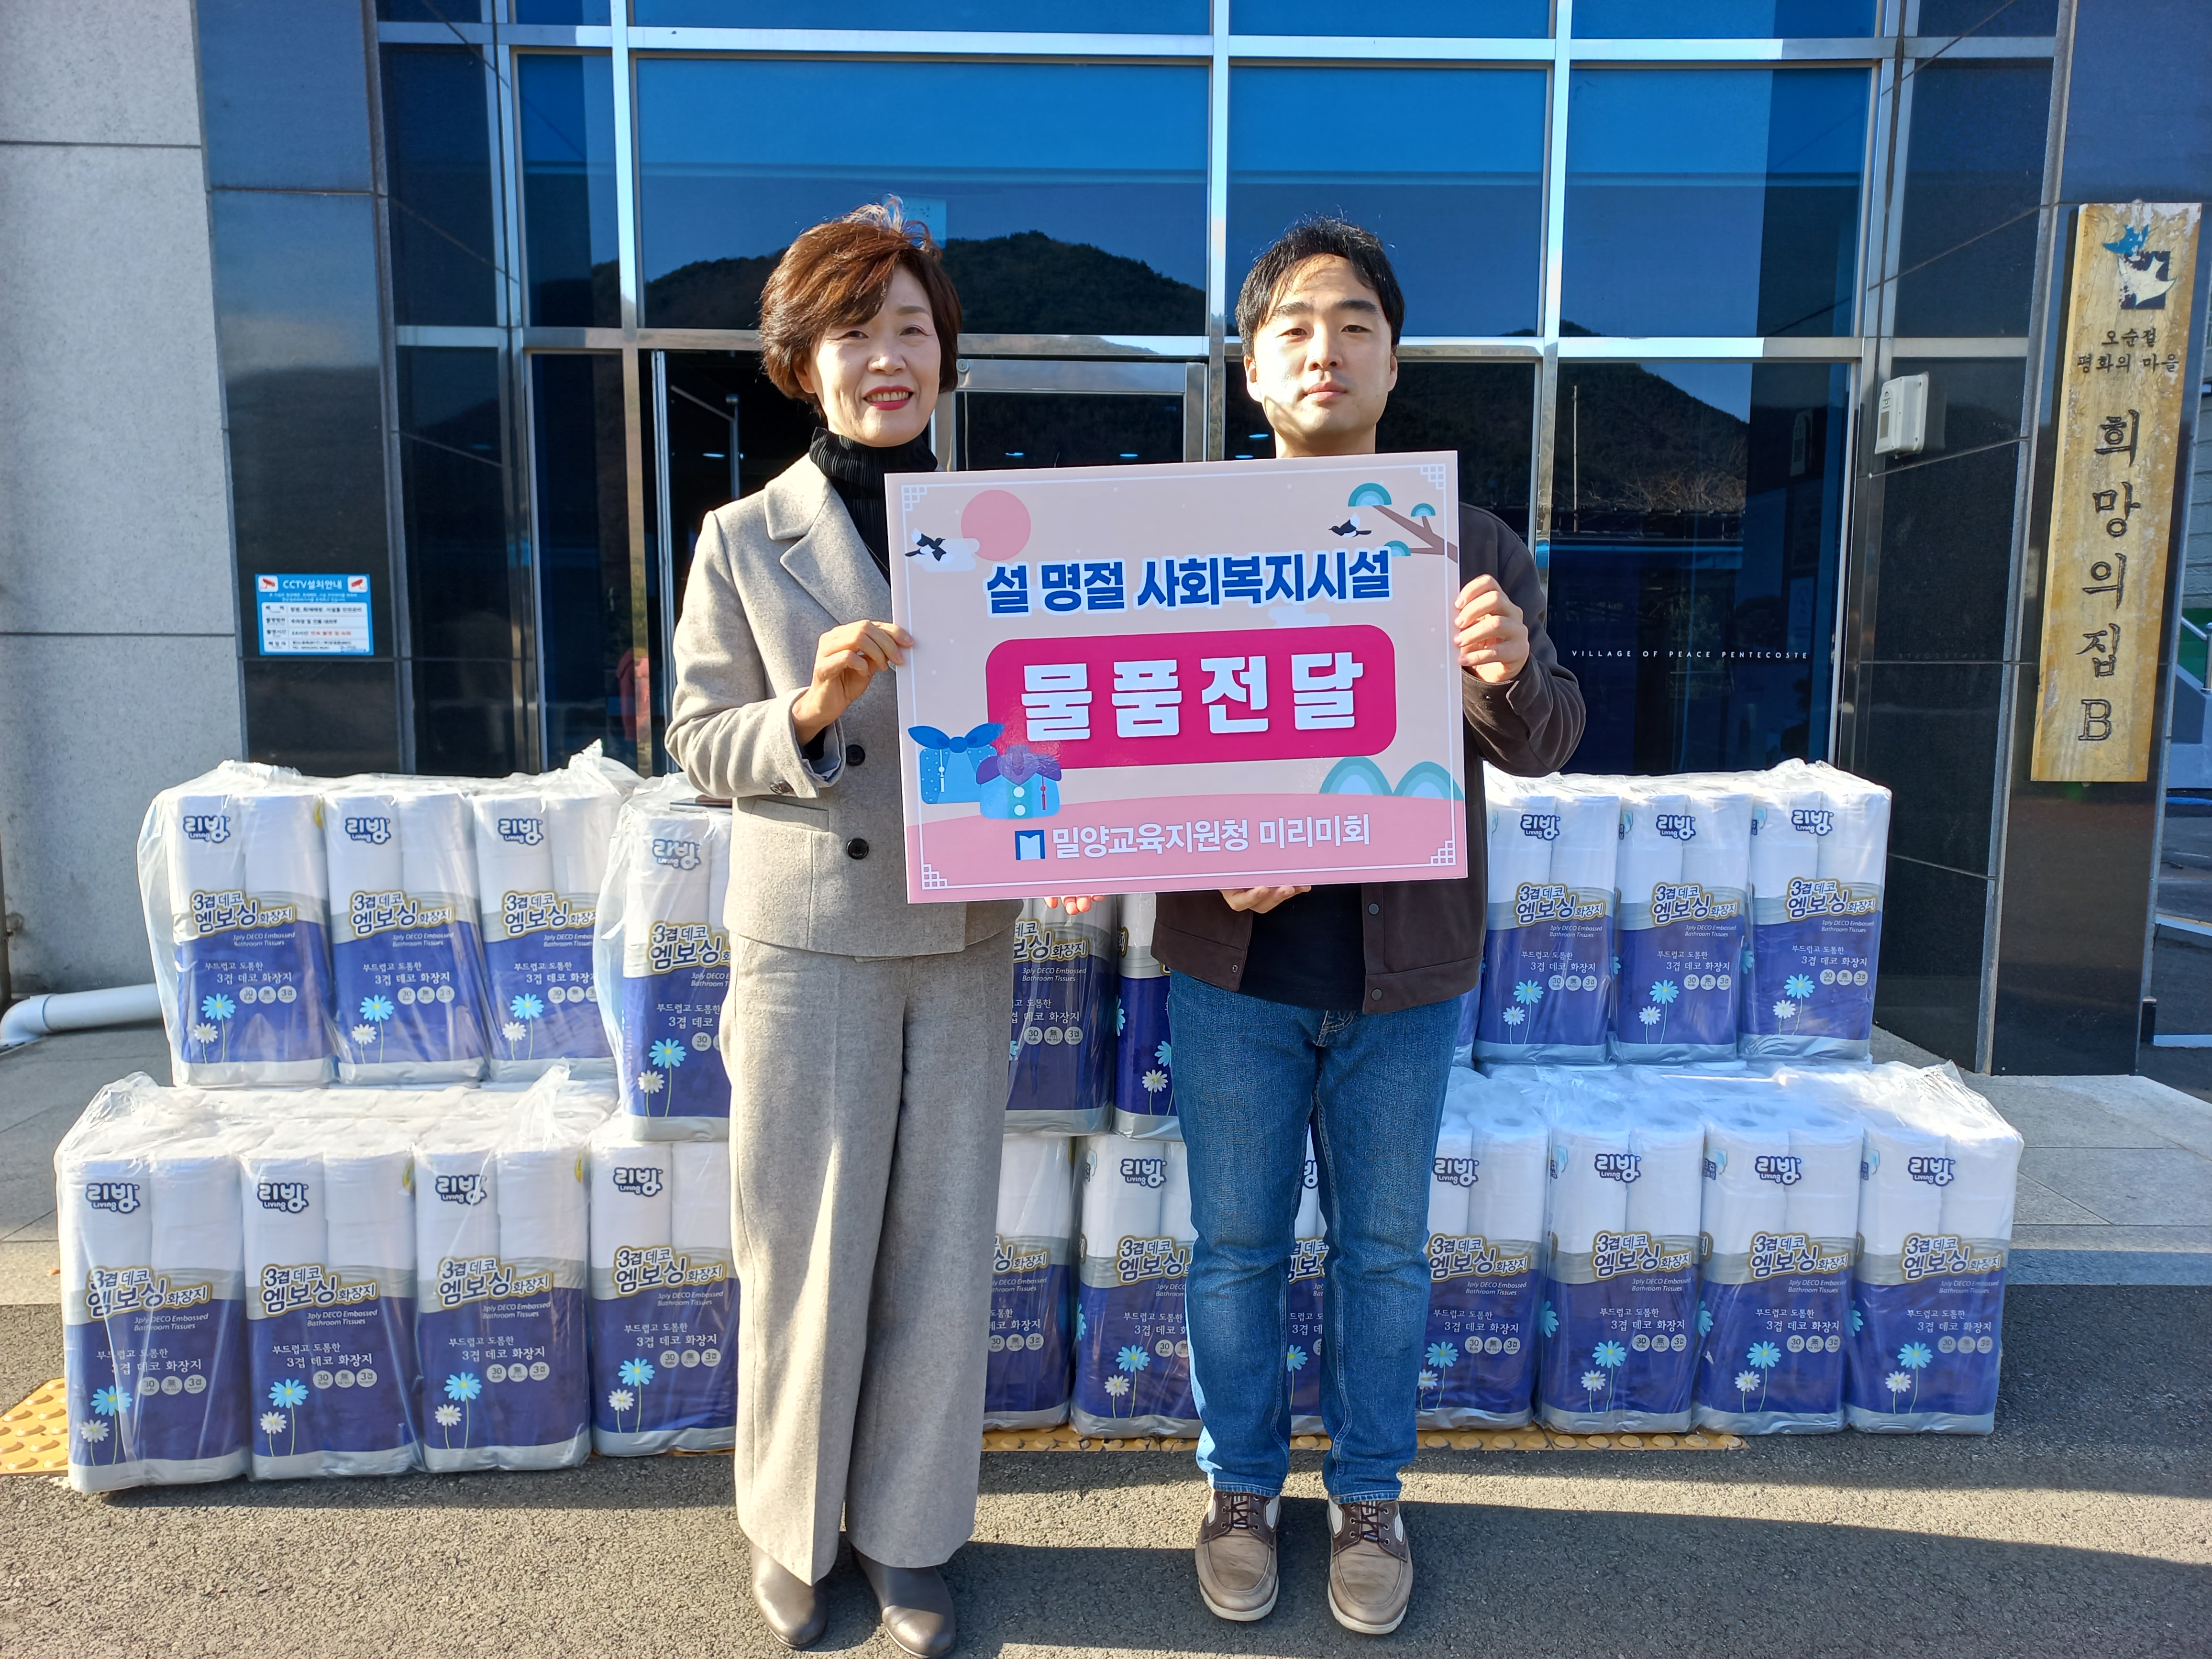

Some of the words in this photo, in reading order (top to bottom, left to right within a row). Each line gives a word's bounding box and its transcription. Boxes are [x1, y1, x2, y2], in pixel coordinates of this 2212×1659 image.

[2078, 353, 2131, 373] 평화의
[2143, 353, 2179, 372] 마을
[283, 579, 342, 590] CCTV설치안내
[987, 565, 1029, 613] 설
[1042, 561, 1125, 611] 명절
[1138, 550, 1391, 608] 사회복지시설
[2078, 699, 2112, 741] B
[184, 815, 231, 843] 리빙
[346, 817, 391, 845] 리빙
[499, 818, 543, 846] 리빙
[1521, 815, 1560, 840] 리빙
[1657, 815, 1695, 840] 리빙
[1792, 810, 1833, 835] 리빙
[1053, 818, 1249, 859] 밀양교육지원청
[1260, 813, 1370, 848] 미리미회
[1519, 885, 1540, 901] 3겹
[1542, 886, 1563, 899] 데코
[1656, 885, 1676, 901] 3겹
[1678, 886, 1698, 899] 데코
[1791, 880, 1812, 896] 3겹
[1814, 882, 1835, 894] 데코
[192, 893, 215, 910] 3겹
[218, 893, 242, 907] 데코
[353, 893, 376, 911] 3겹
[379, 893, 402, 907] 데코
[505, 894, 528, 911] 3겹
[531, 894, 553, 908] 데코
[1517, 895, 1574, 923] 엠보싱
[1574, 903, 1603, 917] 화장지
[1653, 895, 1710, 923] 엠보싱
[1710, 902, 1737, 917] 화장지
[1788, 890, 1847, 918] 엠보싱
[1847, 898, 1876, 912] 화장지
[258, 908, 291, 924] 화장지
[352, 902, 418, 935] 엠보싱
[418, 908, 451, 924] 화장지
[504, 902, 568, 934] 엠보싱
[653, 925, 678, 943] 3겹
[681, 926, 706, 941] 데코
[650, 937, 721, 970] 엠보싱
[1051, 941, 1085, 957] 화장지
[1657, 951, 1684, 959] 부드럽고
[1667, 962, 1680, 972] 3겹
[1685, 962, 1702, 970] 데코
[1705, 962, 1730, 972] 화장지
[656, 1003, 691, 1013] 부드럽고
[669, 1017, 686, 1029] 3겹
[692, 1018, 713, 1027] 데코
[1121, 1159, 1167, 1187] 리빙
[1434, 1159, 1479, 1186] 리빙
[1596, 1154, 1641, 1182] 리빙
[1756, 1156, 1802, 1184] 리빙
[1909, 1158, 1954, 1185] 리빙
[614, 1167, 663, 1196] 리빙
[87, 1182, 140, 1214] 리빙
[258, 1182, 309, 1214] 리빙
[1121, 1239, 1144, 1257] 3겹
[1147, 1240, 1171, 1255] 데코
[1432, 1237, 1455, 1254] 3겹
[1458, 1239, 1482, 1253] 데코
[1596, 1234, 1620, 1252] 3겹
[1623, 1235, 1646, 1250] 데코
[1754, 1235, 1778, 1253] 3겹
[1781, 1236, 1804, 1250] 데코
[1907, 1237, 1930, 1254] 3겹
[1933, 1238, 1956, 1252] 데코
[441, 1259, 466, 1279] 3겹
[469, 1259, 495, 1275] 데코
[617, 1249, 642, 1268] 3겹
[645, 1249, 671, 1264] 데코
[1013, 1252, 1046, 1269] 화장지
[1118, 1250, 1184, 1282] 엠보싱
[1429, 1249, 1495, 1279] 엠보싱
[1495, 1257, 1526, 1272] 화장지
[1594, 1244, 1660, 1277] 엠보싱
[1660, 1252, 1692, 1269] 화장지
[1751, 1246, 1817, 1277] 엠보싱
[1817, 1254, 1849, 1270] 화장지
[1903, 1247, 1969, 1279] 엠보싱
[121, 1269, 149, 1286] 데코
[264, 1267, 290, 1287] 3겹
[293, 1267, 320, 1283] 데코
[615, 1258, 686, 1293] 엠보싱
[686, 1265, 722, 1282] 화장지
[166, 1286, 205, 1305] 화장지
[262, 1276, 337, 1313] 엠보싱
[337, 1283, 375, 1301] 화장지
[439, 1269, 511, 1305] 엠보싱
[511, 1275, 548, 1294] 화장지
[343, 1309, 376, 1317] Embossed
[1756, 1308, 1787, 1318] 부드럽고
[1767, 1321, 1782, 1332] 3겹
[1788, 1321, 1807, 1330] 데코
[1811, 1321, 1840, 1333] 화장지
[272, 1344, 309, 1355] 부드럽고
[287, 1357, 305, 1370] 3겹
[311, 1356, 333, 1366] 데코
[338, 1353, 372, 1367] 화장지
